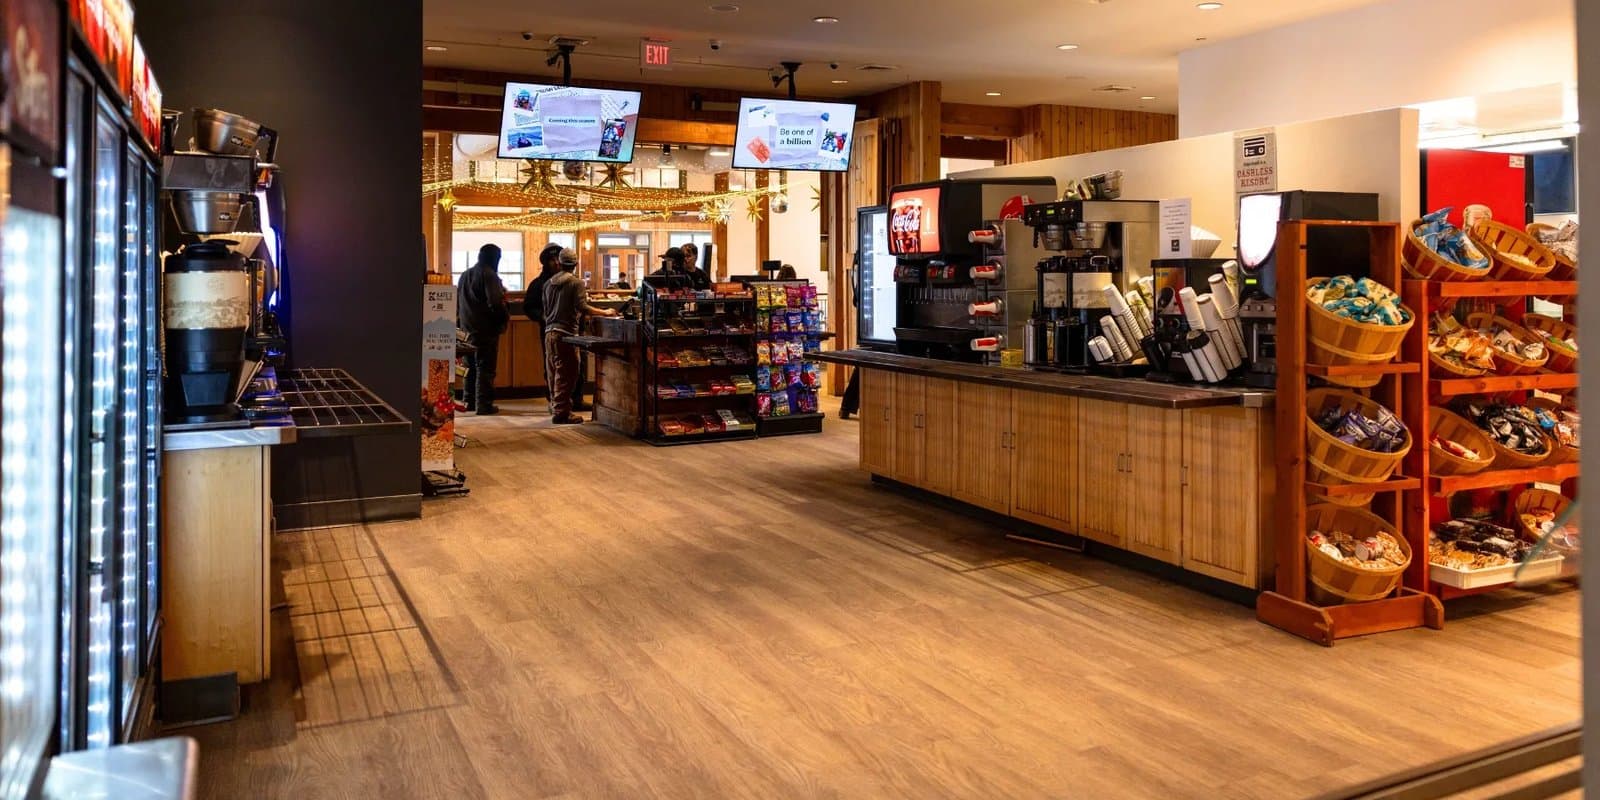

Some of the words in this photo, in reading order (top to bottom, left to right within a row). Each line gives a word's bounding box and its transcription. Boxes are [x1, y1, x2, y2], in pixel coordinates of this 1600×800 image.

[646, 45, 670, 65] EXIT
[779, 128, 789, 136] Be
[806, 128, 814, 136] of
[1237, 166, 1273, 178] CASHLESS
